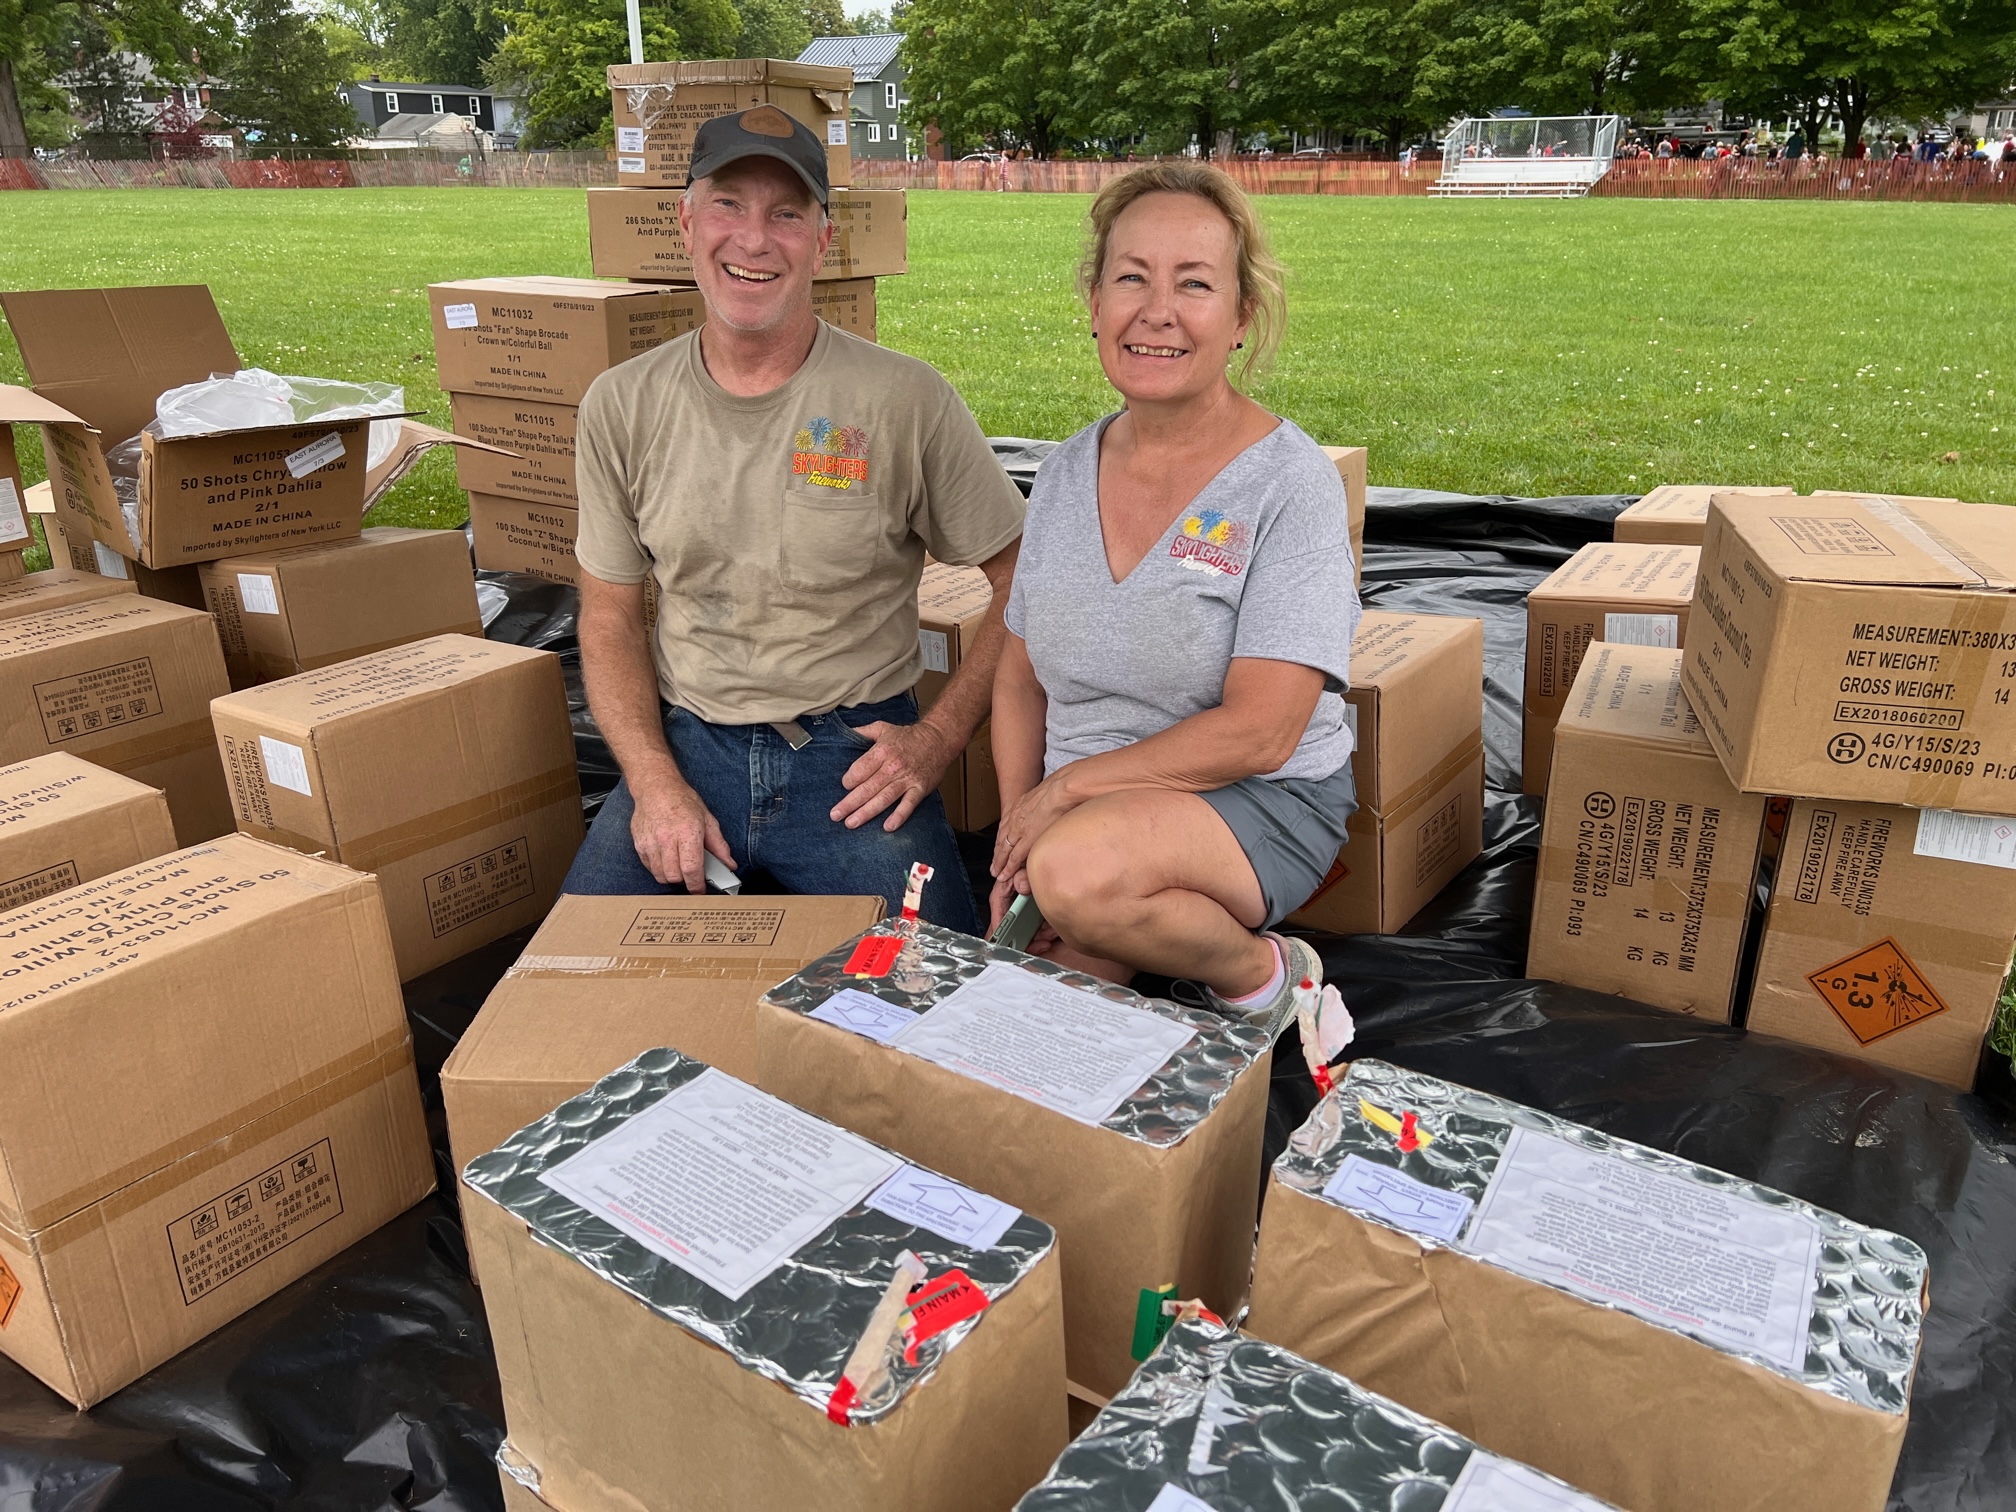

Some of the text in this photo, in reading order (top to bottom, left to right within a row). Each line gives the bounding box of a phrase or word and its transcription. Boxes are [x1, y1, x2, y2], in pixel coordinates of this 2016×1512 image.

[654, 228, 680, 238] Purple
[492, 308, 533, 320] MC11032
[477, 336, 552, 350] Crown w/Colorful Ball
[494, 325, 513, 335] "Fan"
[515, 327, 537, 338] Shape
[539, 329, 568, 340] Brocade
[508, 355, 521, 363] 1/1
[490, 367, 511, 376] MADE
[522, 370, 547, 379] CHINA
[515, 413, 555, 426] MC11015
[480, 425, 498, 435] Shots
[499, 427, 516, 436] "Fan"
[518, 430, 537, 440] Shape
[538, 432, 550, 442] Pop
[289, 434, 337, 464] EAST AURORA
[514, 440, 535, 451] Purple
[536, 443, 557, 454] Dahlia
[529, 460, 542, 468] 1/1
[792, 452, 869, 482] SKYLIGHTERS
[181, 478, 198, 490] 50
[203, 473, 248, 488] Shots
[512, 471, 532, 480] MADE
[543, 475, 567, 485] CHINA
[207, 480, 322, 504] and Pink Dahlia
[255, 501, 278, 513] 2/1
[213, 510, 313, 532] MADE IN CHINA
[528, 512, 564, 527] MC11012
[182, 541, 220, 553] Imported
[234, 532, 279, 546] Skylighters
[290, 528, 307, 536] New
[308, 524, 325, 533] York
[326, 521, 341, 530] LLC
[496, 522, 573, 546] 100 Shots "Z" Shape
[508, 535, 564, 555] Coconut w/Big
[542, 557, 554, 566] 1/1
[1170, 535, 1247, 576] SKYLIGHTERS
[526, 568, 544, 577] MADE
[554, 574, 574, 584] CHINA
[1563, 631, 1571, 650] KEEP
[1543, 626, 1554, 694] EX2019022633
[1846, 650, 1876, 667] NET
[1879, 652, 1940, 672] WEIGHT:
[1561, 668, 1570, 688] AWAY
[1839, 676, 2011, 704] GROSS WEIGHT: 14
[1839, 706, 1957, 726] EX2018060200
[1872, 732, 1981, 756] 4G/Y15/S/23
[1867, 753, 1974, 776] CN/C490069
[240, 748, 259, 813] KEEP FIRE AWAY
[243, 742, 267, 824] HANDLE CAREFULLY
[249, 740, 275, 830] FIREWORKS UN0335
[1617, 802, 1639, 883] EX2019022178
[1592, 822, 1615, 897] 4G/Y15/S/23
[1800, 815, 1830, 900] EX2019022178
[1830, 825, 1856, 897] KEEP FIRE AWAY
[1841, 819, 1872, 909] HANDLE CAREFULLY
[1854, 818, 1892, 916] FIREWORKS UN0335
[118, 869, 190, 896] MADE
[1567, 820, 1595, 936] CN/C490069 PI:093
[1627, 800, 1666, 961] GROSS WEIGHT: 14 KG
[1652, 803, 1693, 966] NET WEIGHT: 13 KG
[1678, 807, 1720, 972] MEASUREMENT:375X375X245 MM
[85, 901, 132, 920] 2/1
[88, 896, 116, 907] IN
[0, 869, 290, 981] 50 Shots Chrys Willo
[11, 876, 229, 959] and Pink Dahlia
[95, 904, 229, 957] MC11053-2
[1832, 978, 1848, 990] G
[1848, 971, 1879, 1008] 1.3
[926, 1288, 961, 1311] MAIN
